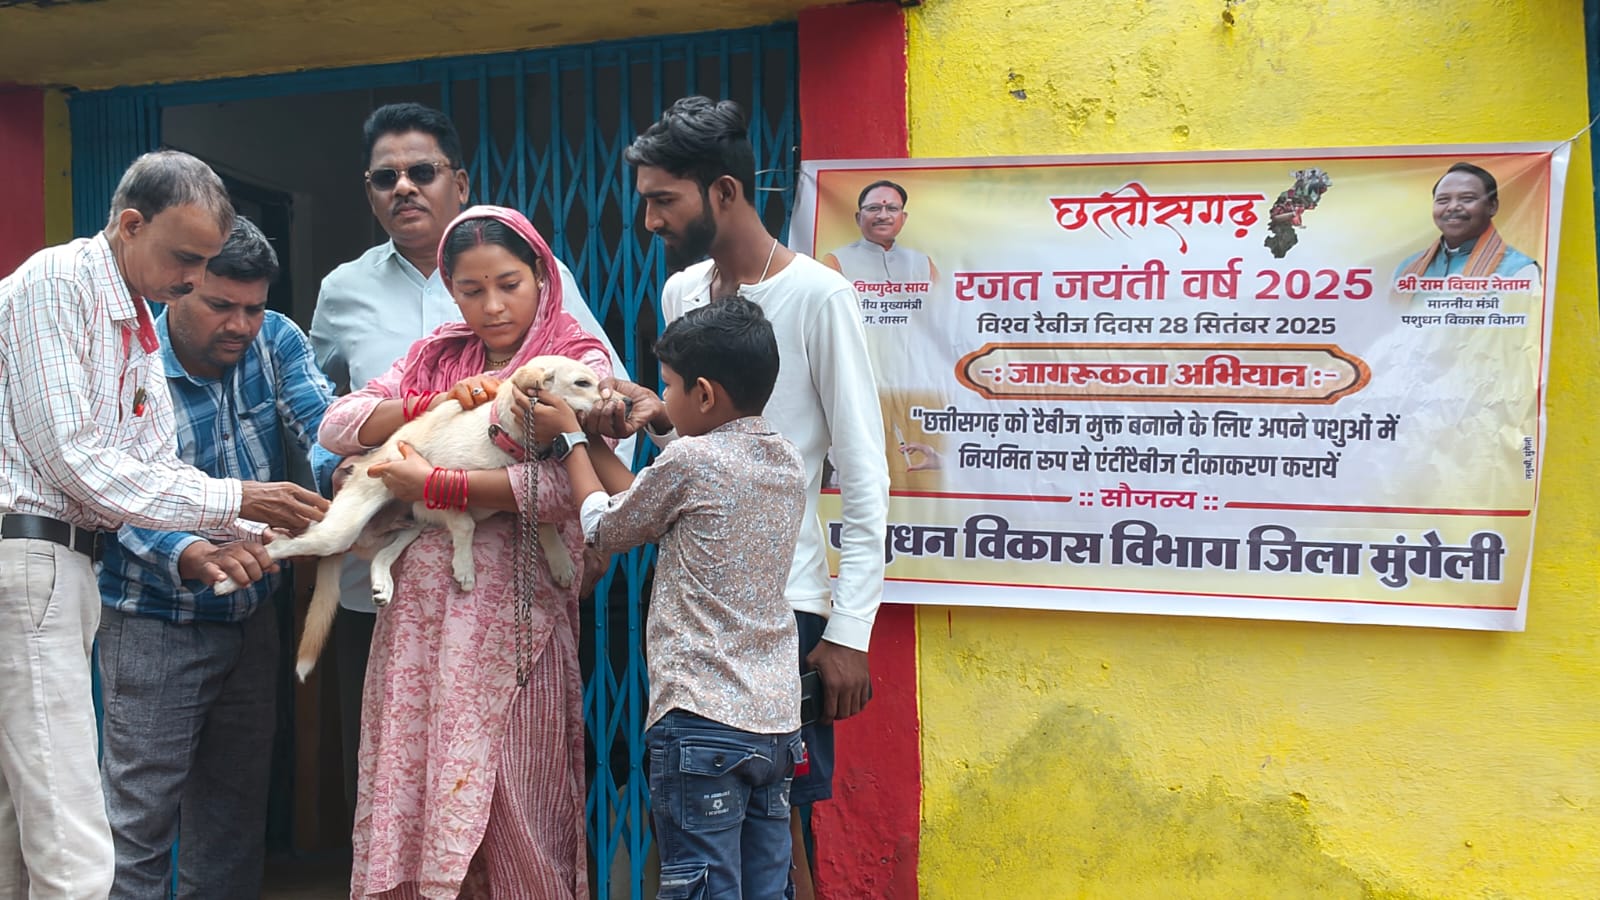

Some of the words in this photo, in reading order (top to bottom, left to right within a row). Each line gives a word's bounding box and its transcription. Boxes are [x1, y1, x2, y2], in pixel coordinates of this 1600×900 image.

[904, 283, 928, 293] साय
[955, 271, 1042, 301] रजत
[1053, 259, 1169, 301] जयंती
[1182, 258, 1243, 300] वर्ष
[1255, 269, 1373, 300] 2025
[1398, 278, 1416, 291] श्री
[1420, 281, 1445, 291] राम
[1448, 277, 1489, 291] विचार
[1492, 277, 1530, 290] नेताम
[880, 299, 921, 313] मुख्यमंत्री
[1427, 299, 1472, 309] माननीय
[1476, 297, 1499, 309] मंत्री
[879, 316, 908, 324] शासन
[978, 314, 1027, 333] विश्व
[1035, 311, 1087, 333] रैबीज
[1095, 314, 1151, 333] दिवस
[1160, 318, 1187, 333] 28
[1195, 312, 1270, 333] सितंबर
[1276, 318, 1336, 334] 2025
[1401, 315, 1441, 328] पशुधन
[1445, 314, 1484, 325] विकास
[1488, 314, 1525, 326] विभाग
[1175, 355, 1307, 386] अभियान
[1004, 408, 1029, 433] को
[1033, 408, 1080, 435] रैबीज
[1086, 415, 1123, 441] मुक्त
[1128, 411, 1183, 437] बनाने
[1188, 412, 1208, 437] के
[1213, 411, 1252, 438] लिए
[1259, 413, 1308, 439] अपने
[1313, 414, 1372, 447] पशुओं
[1376, 415, 1401, 440] में
[959, 443, 1032, 470] नियमित
[1036, 449, 1067, 471] रूप
[1071, 446, 1090, 471] से
[1181, 452, 1276, 477] टीकाकरण
[1282, 452, 1342, 478] करायें
[1100, 482, 1196, 509] सौजन्य
[964, 514, 1103, 564] विकास
[1110, 520, 1239, 569] विभाग
[1247, 525, 1362, 575] जिला
[1369, 531, 1505, 588] मुंगेली
